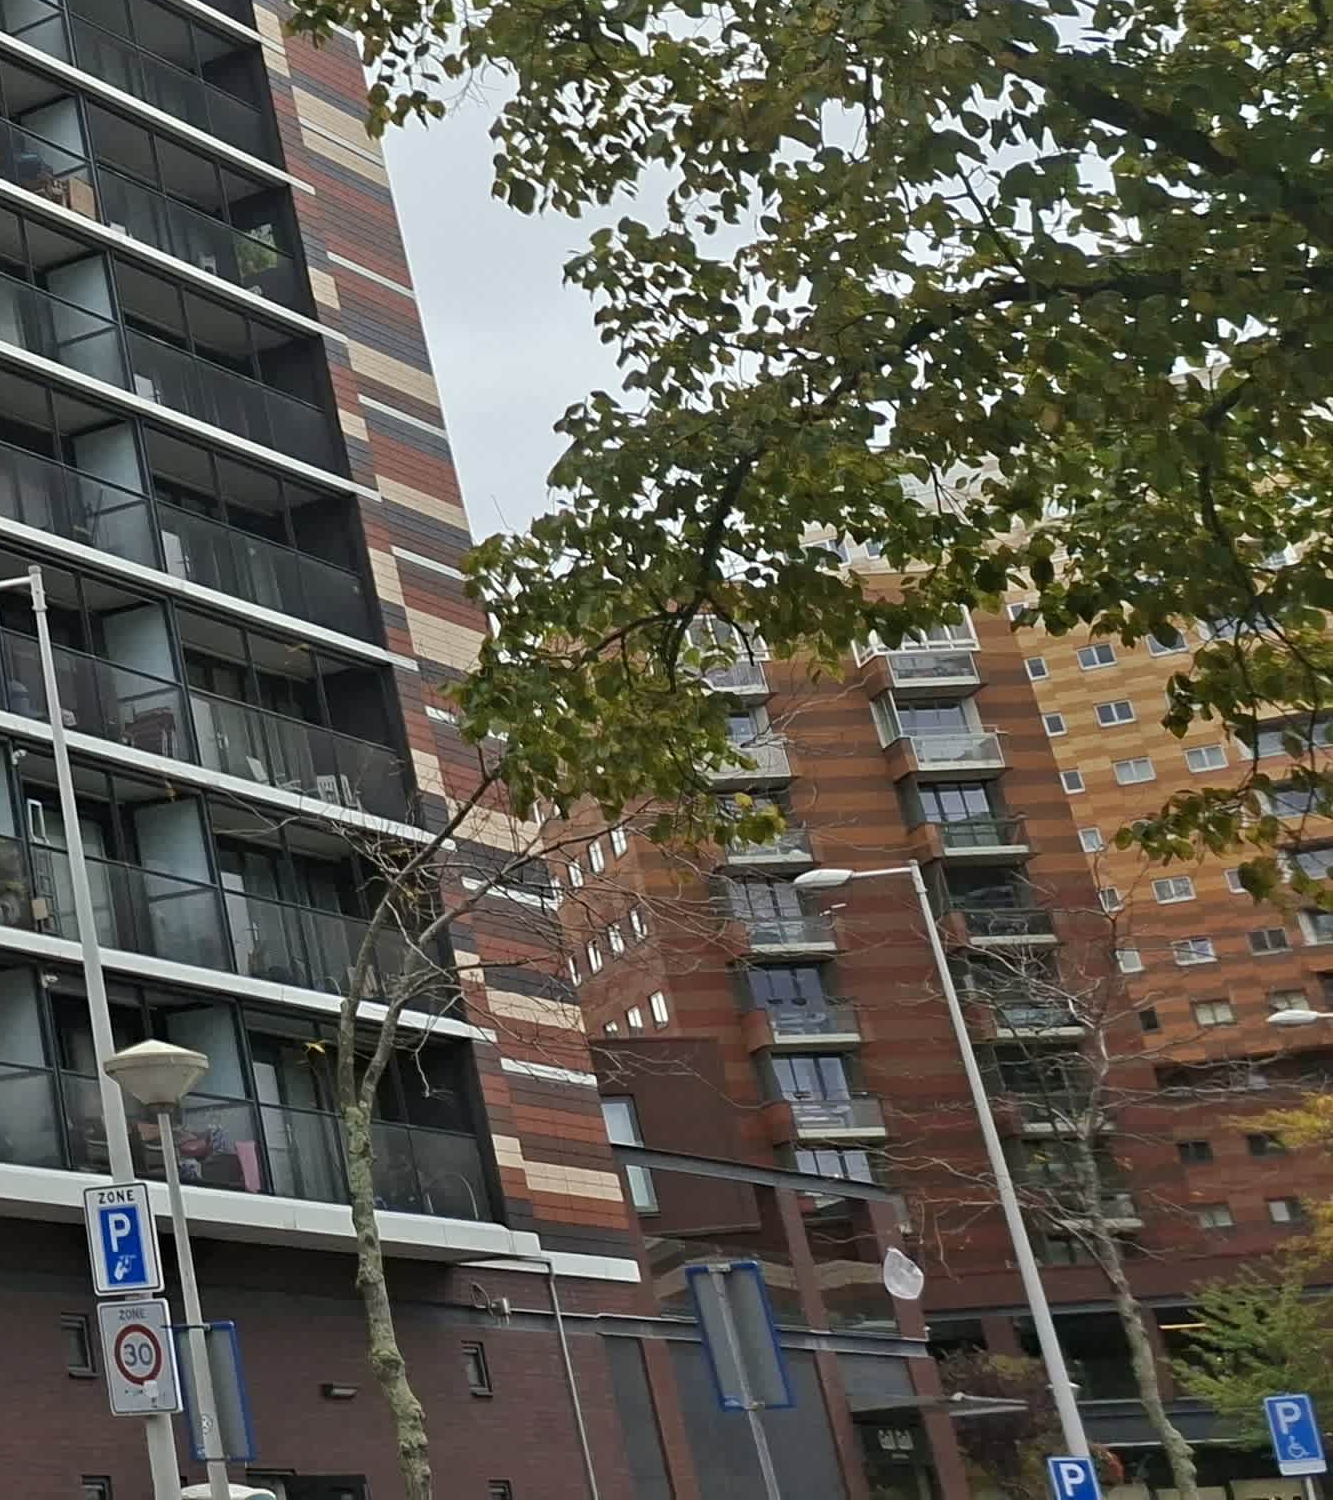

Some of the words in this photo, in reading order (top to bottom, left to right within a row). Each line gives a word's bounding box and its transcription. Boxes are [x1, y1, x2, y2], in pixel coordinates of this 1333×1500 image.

[98, 1189, 135, 1204] ZONE
[108, 1212, 131, 1252] P
[118, 1307, 145, 1320] ZONE
[123, 1342, 153, 1367] 30
[1275, 1402, 1301, 1435] P
[1059, 1463, 1085, 1497] P
